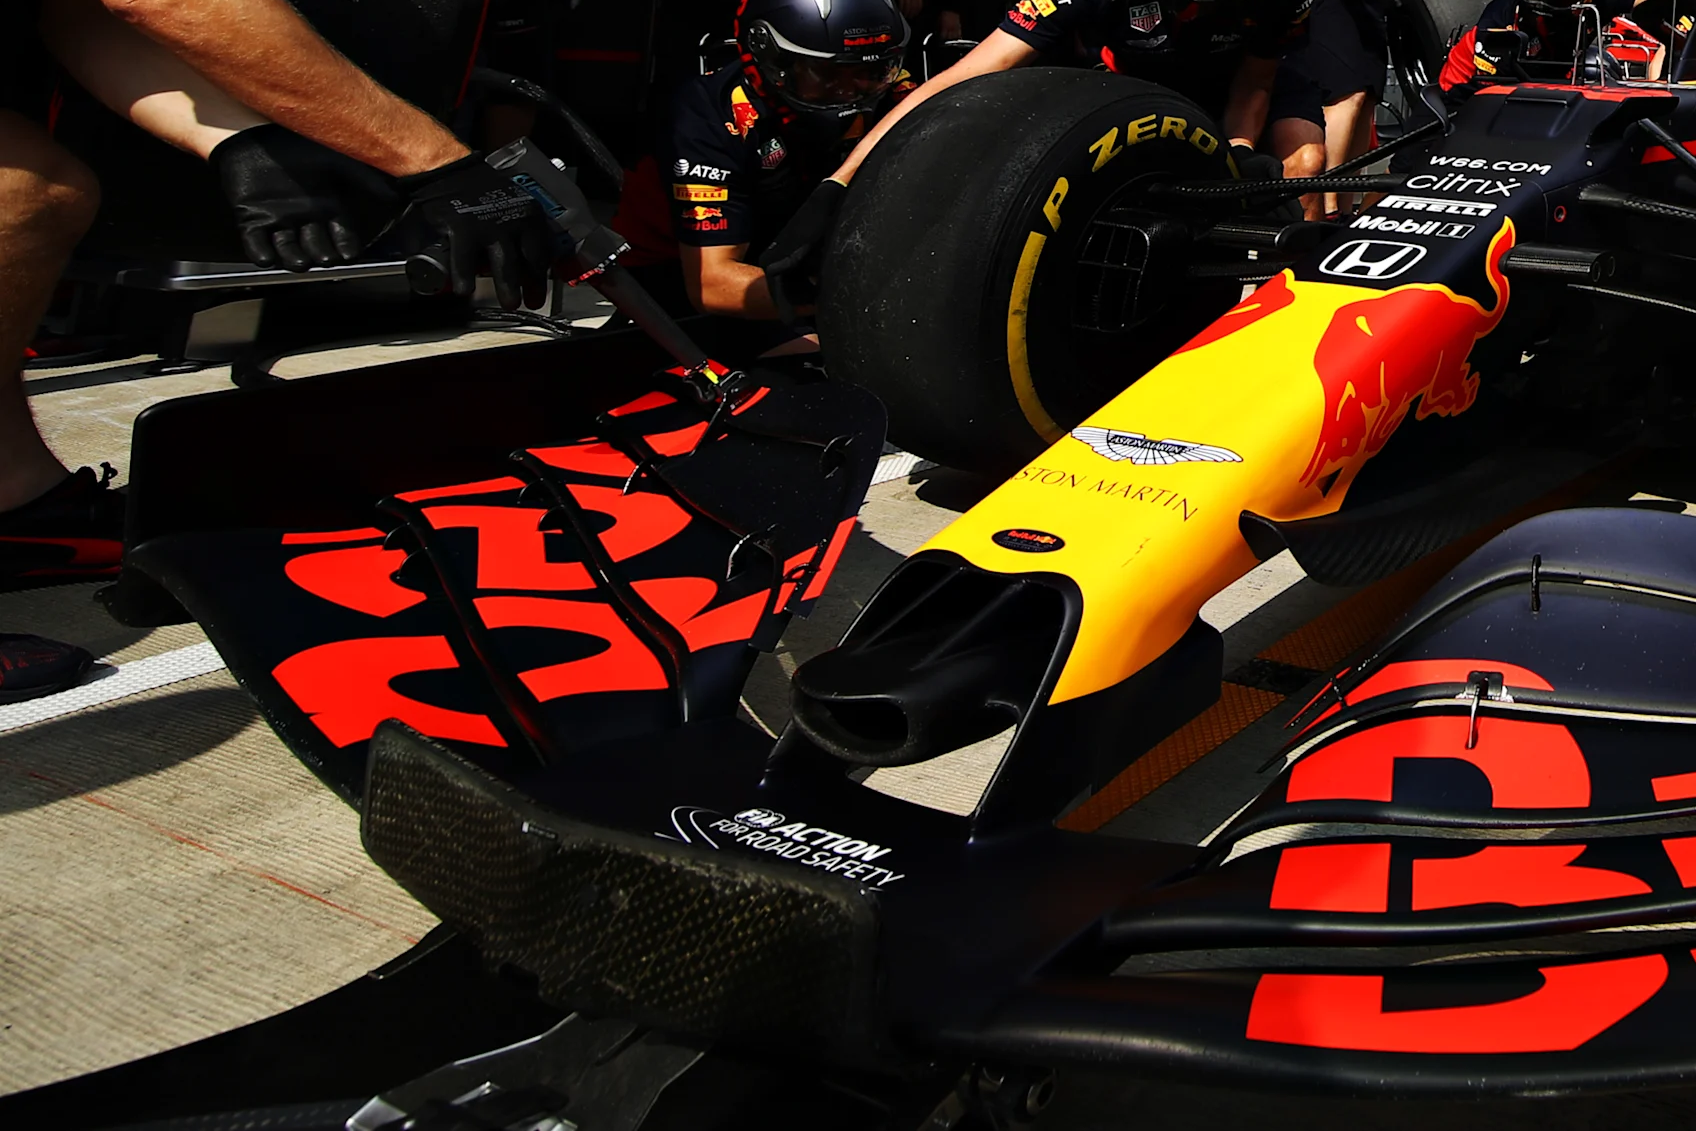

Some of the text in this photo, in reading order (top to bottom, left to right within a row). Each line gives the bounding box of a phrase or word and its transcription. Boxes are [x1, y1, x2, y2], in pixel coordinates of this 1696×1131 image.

[1131, 3, 1158, 17] TAG
[689, 164, 732, 182] AT&T
[1042, 113, 1219, 233] P ZERO
[1376, 194, 1498, 217] PIRELLI
[1349, 214, 1441, 236] Mobil
[1011, 466, 1198, 522] STON MARTIN
[708, 818, 906, 888] FOR ROAD SAFETY
[769, 821, 893, 862] ACTION
